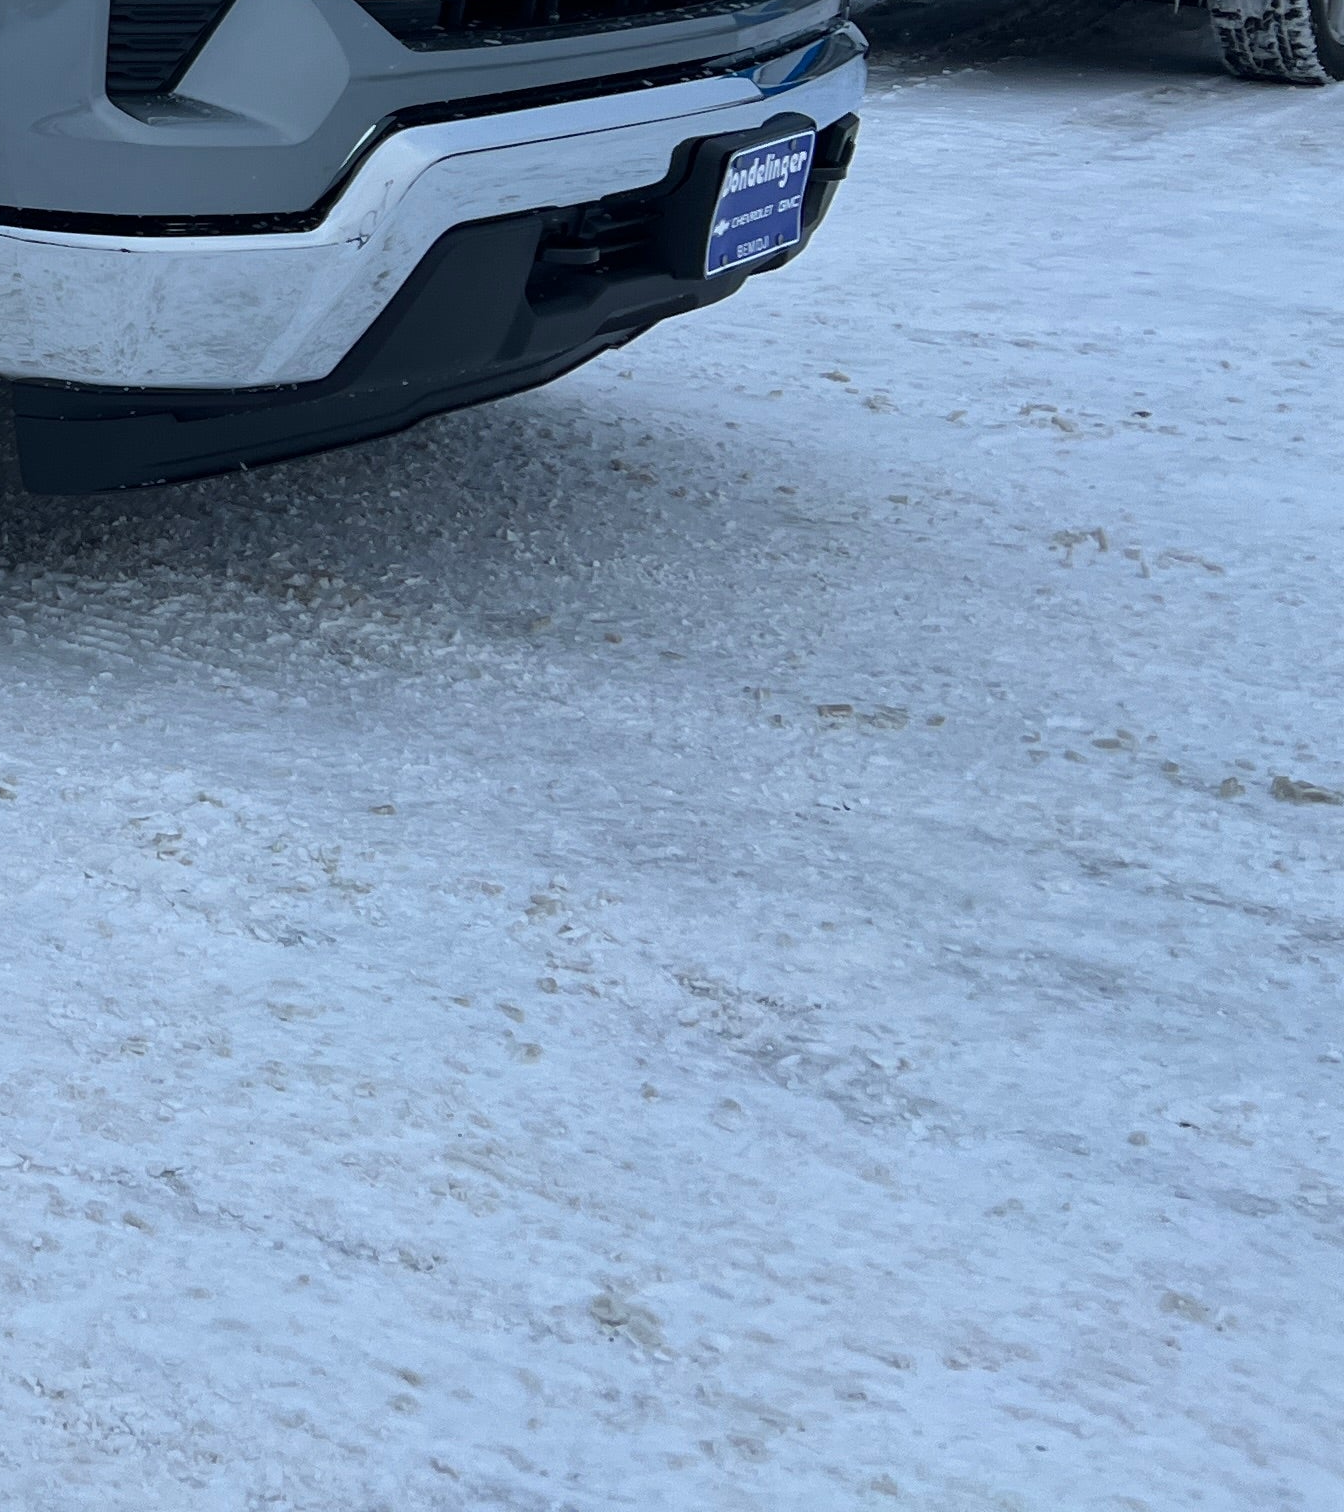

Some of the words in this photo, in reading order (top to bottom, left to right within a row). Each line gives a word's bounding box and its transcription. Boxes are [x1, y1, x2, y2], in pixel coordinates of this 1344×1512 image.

[731, 205, 774, 229] CHEVROLET
[778, 194, 801, 213] GMC
[736, 235, 770, 259] BEMIDJI
